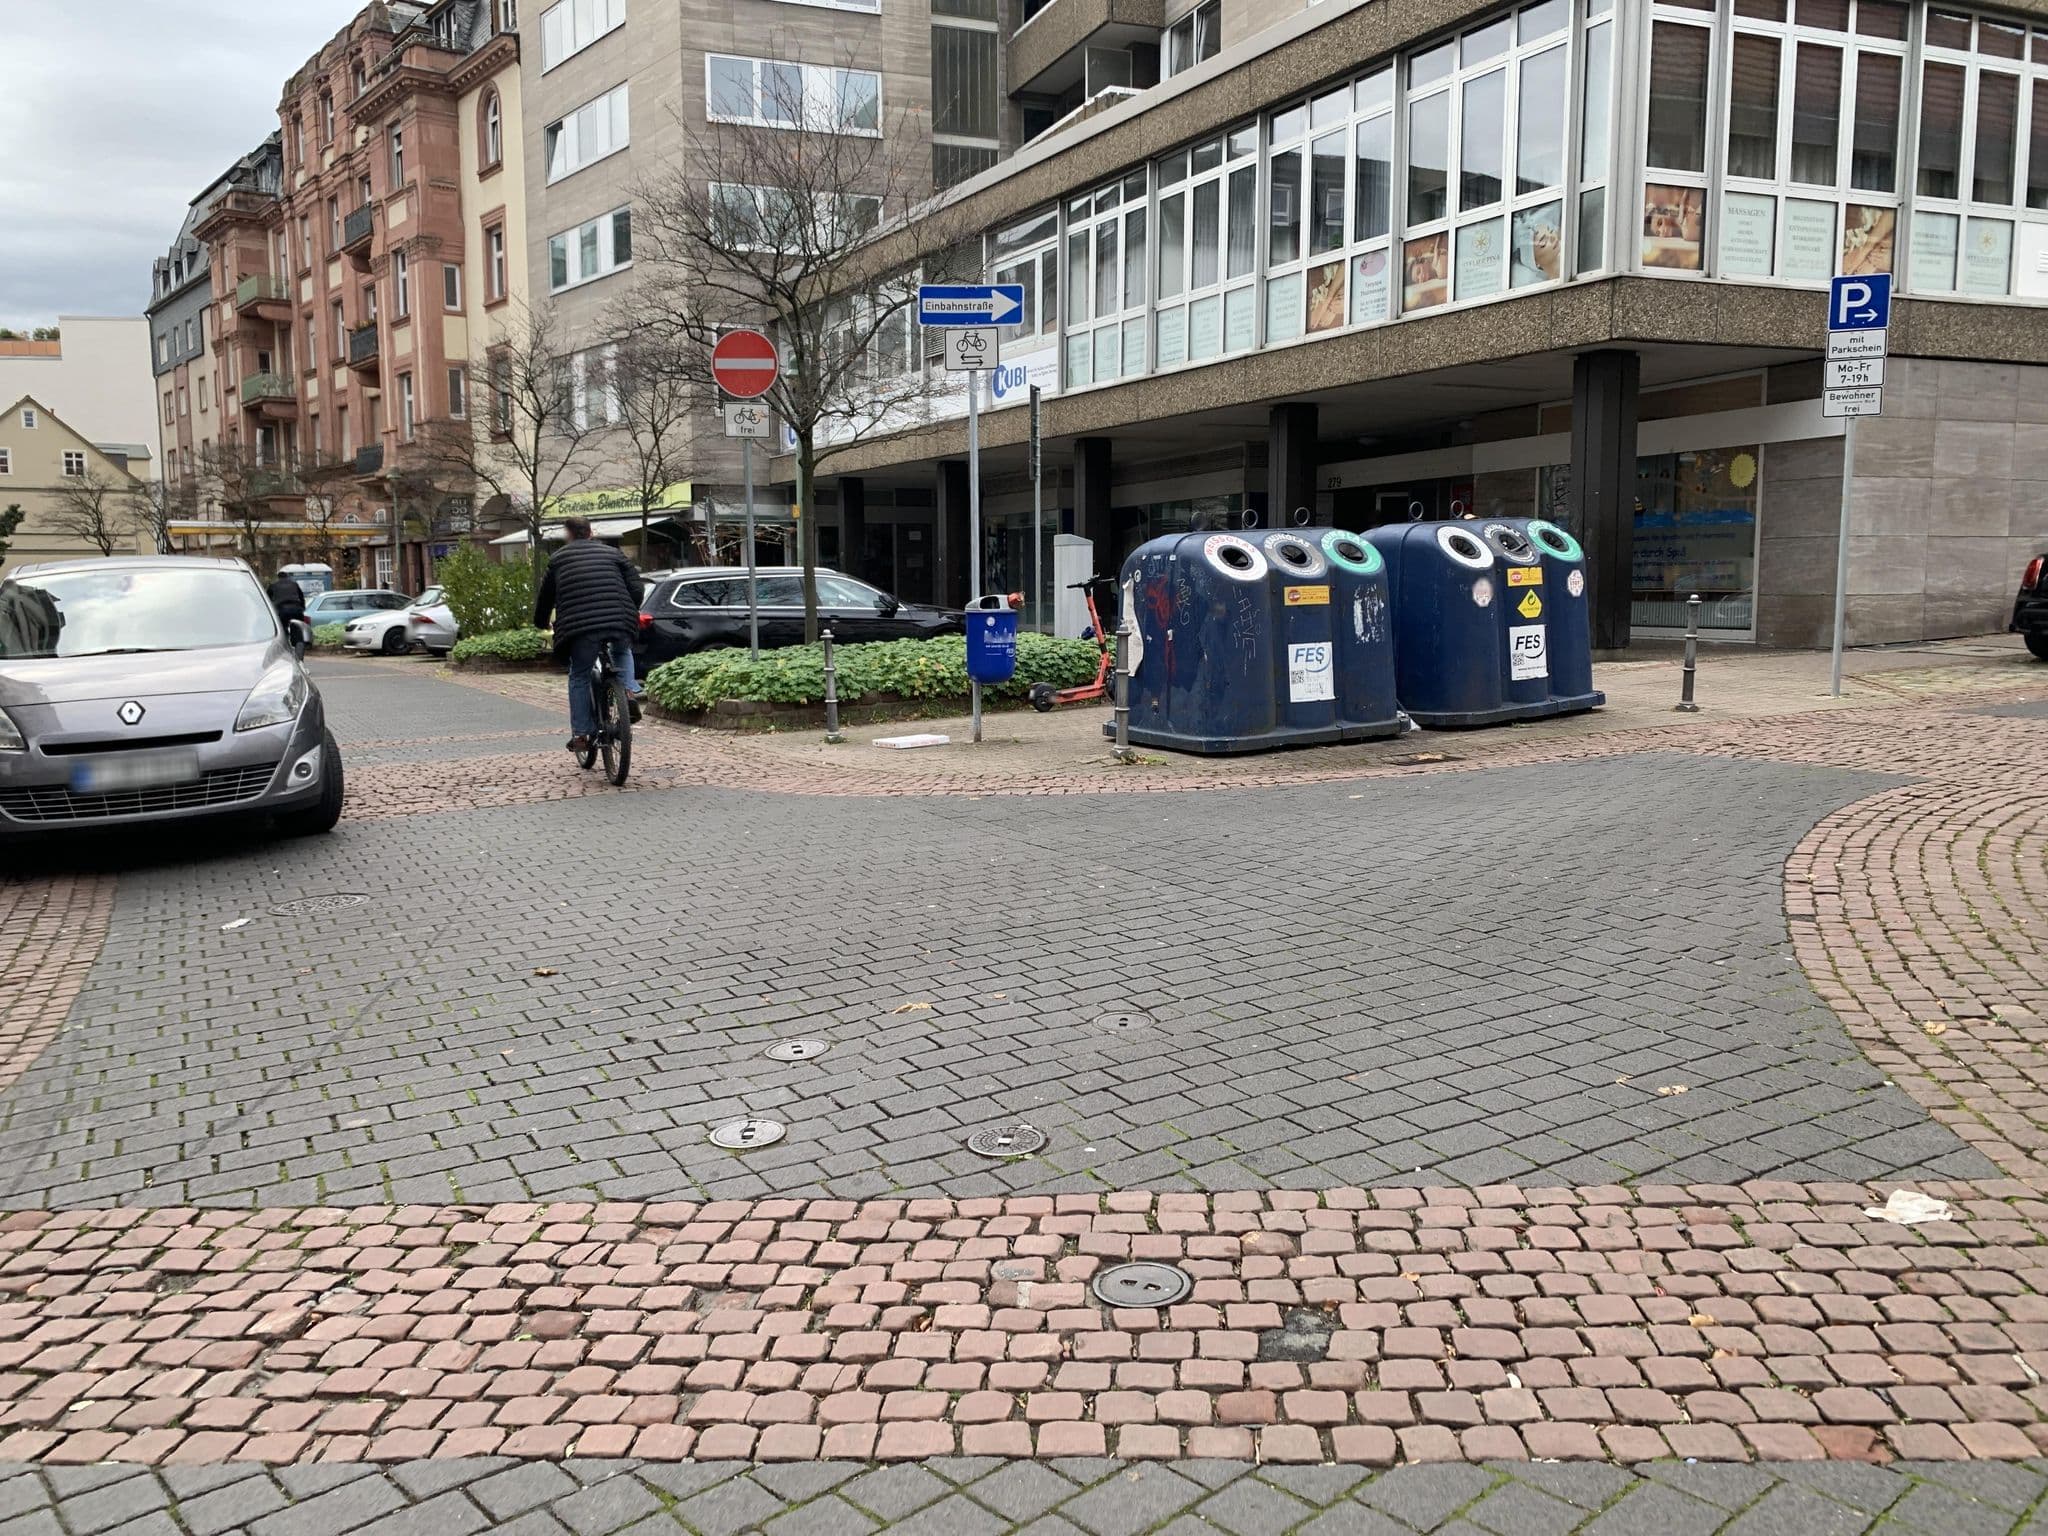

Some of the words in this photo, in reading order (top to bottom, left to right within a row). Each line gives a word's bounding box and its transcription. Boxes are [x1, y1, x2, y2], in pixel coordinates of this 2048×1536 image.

[925, 301, 994, 312] Einbahnstraße
[1839, 283, 1872, 323] P
[1849, 336, 1865, 344] mit
[1831, 344, 1882, 354] Parkschein
[1837, 363, 1872, 373] Mo-Fr
[1829, 390, 1876, 401] Bewohner
[1844, 404, 1860, 413] frei
[740, 426, 756, 434] frei
[1327, 477, 1342, 488] 279
[1515, 634, 1541, 650] FES
[1294, 646, 1326, 664] FES
